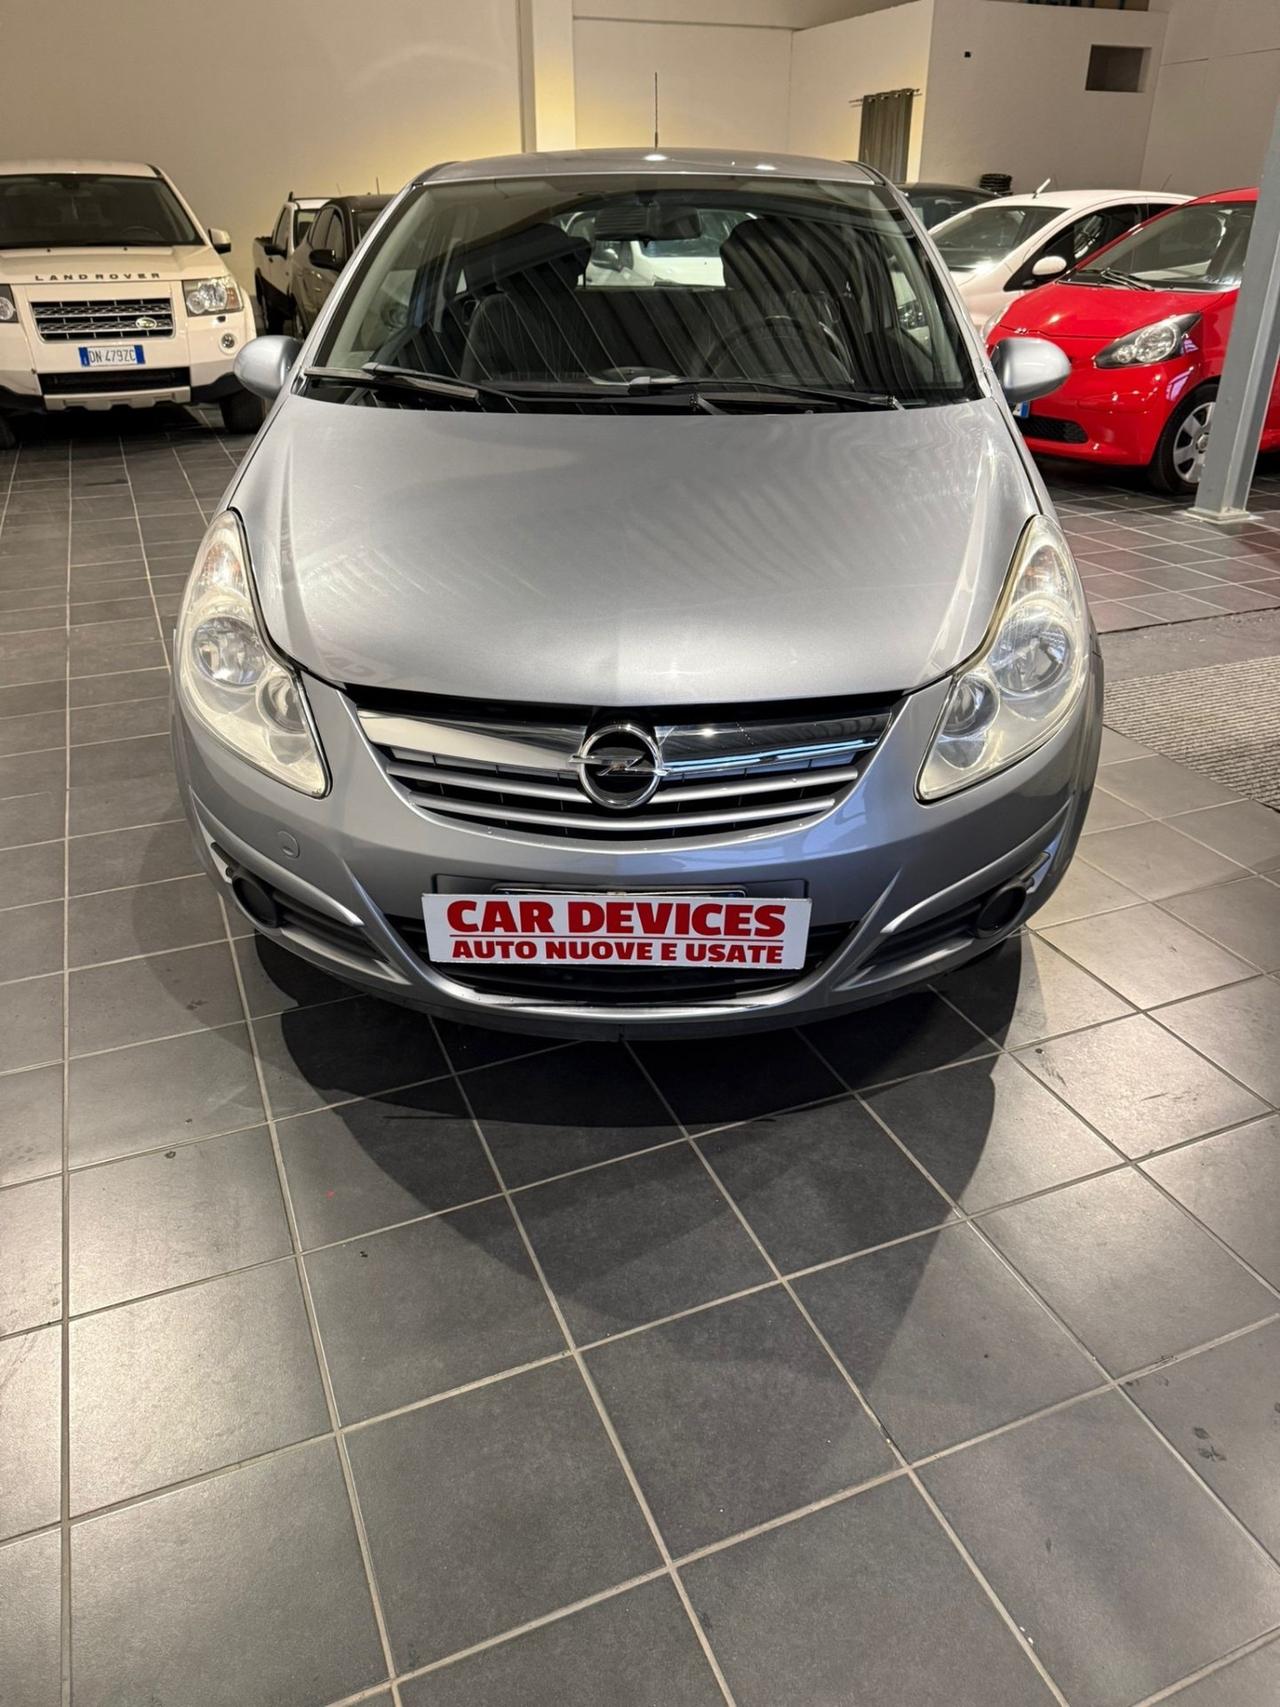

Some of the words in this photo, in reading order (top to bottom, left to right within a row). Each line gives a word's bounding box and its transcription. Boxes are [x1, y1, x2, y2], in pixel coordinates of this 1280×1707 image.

[35, 273, 88, 282] LAND
[95, 272, 160, 281] ROVER
[89, 349, 102, 363] DN
[447, 900, 554, 934] CAR
[567, 901, 785, 938] DEVICES
[452, 940, 537, 960] AUTO
[546, 940, 651, 961] NUOVE
[661, 943, 676, 961] E
[685, 943, 783, 964] USATE
